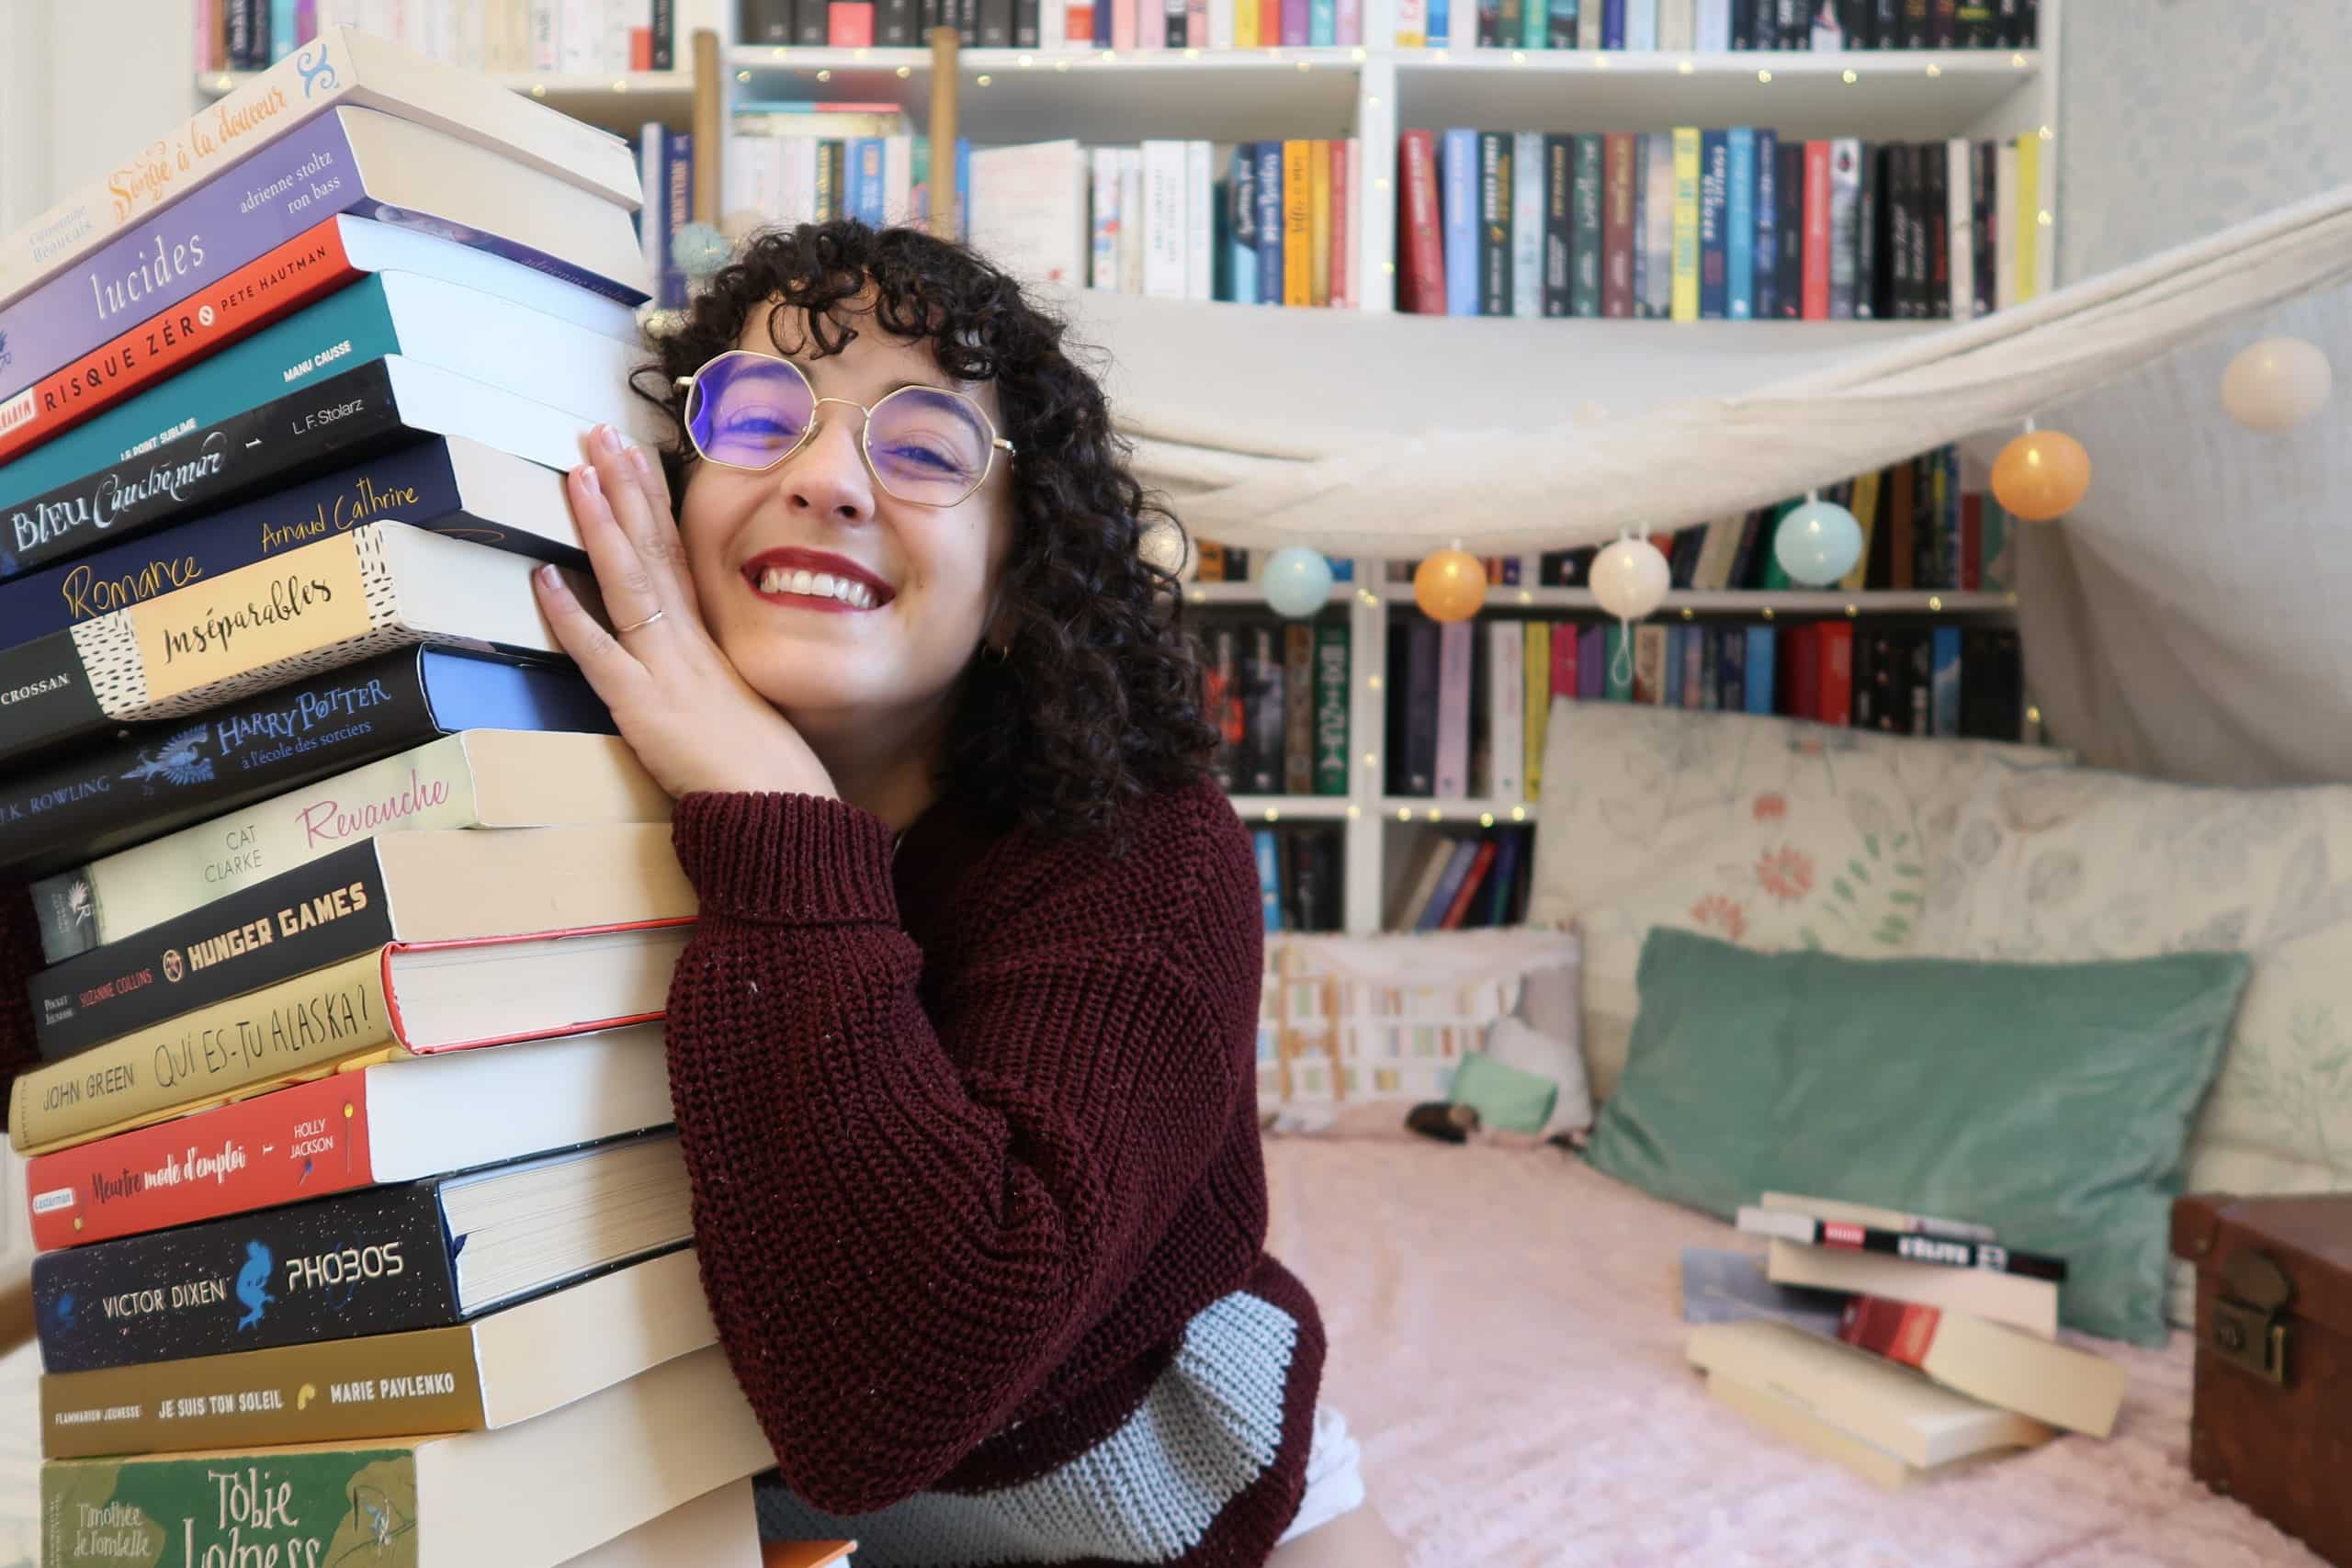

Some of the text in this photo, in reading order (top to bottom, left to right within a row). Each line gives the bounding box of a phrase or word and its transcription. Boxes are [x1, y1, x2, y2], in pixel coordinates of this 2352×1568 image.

[107, 86, 288, 226] Songe à la douceur
[240, 150, 334, 214] adrienne stoltz
[287, 175, 341, 214] ron bass
[91, 233, 207, 321] lucides
[43, 349, 135, 413] RISQUE
[220, 286, 254, 312] PETE
[258, 246, 327, 292] HAUTMAN
[284, 339, 353, 383] MANU CAUSSE
[159, 416, 198, 445] SUBLIME
[317, 397, 365, 426] Stolarz
[62, 478, 420, 620] Romance Arnaud Cathrine
[0, 574, 333, 705] CROSSAN Inséparables
[215, 678, 392, 759] HARRY POTTER
[29, 774, 111, 816] ROWLING
[294, 736, 319, 761] des
[318, 719, 374, 750] sorciers
[225, 824, 257, 851] CAT
[293, 768, 451, 850] Revanche
[203, 849, 264, 884] CLARKE
[187, 881, 368, 973] HUNGER GAMES
[116, 967, 154, 995] COLLINS
[42, 1078, 81, 1113] JOHN
[85, 1063, 134, 1099] GREEN
[289, 1135, 334, 1159] JACKSON
[294, 1118, 326, 1139] HOLLY
[143, 1151, 184, 1190] mode
[182, 1140, 246, 1185] d'emploi
[102, 1241, 404, 1320] VICTOR DIXEN PHOBOS
[158, 1399, 175, 1419] JE
[176, 1397, 206, 1417] SUIS
[208, 1395, 235, 1415] TON
[237, 1389, 285, 1413] SOLEIL
[330, 1380, 375, 1404] MARIE
[379, 1372, 456, 1400] PAVLENKO
[207, 1466, 300, 1530] Tobie
